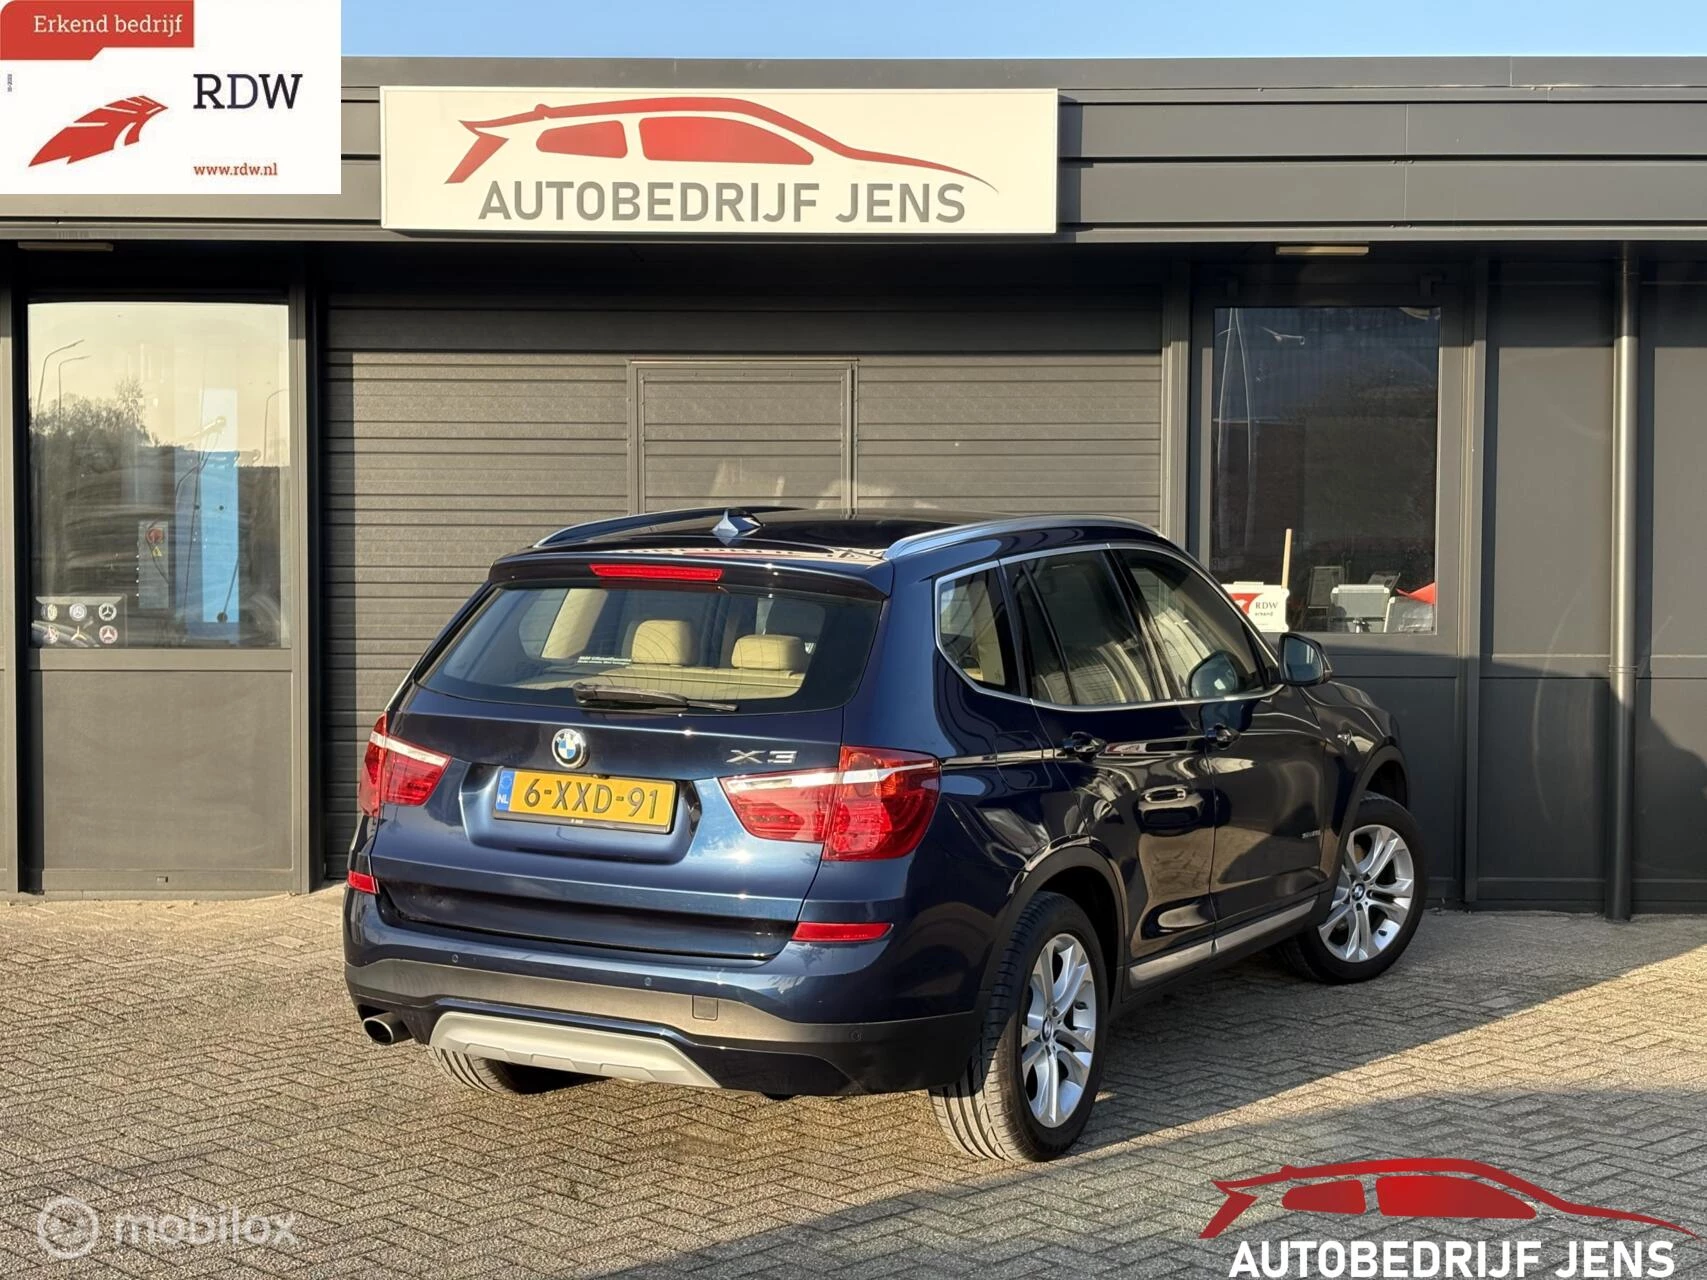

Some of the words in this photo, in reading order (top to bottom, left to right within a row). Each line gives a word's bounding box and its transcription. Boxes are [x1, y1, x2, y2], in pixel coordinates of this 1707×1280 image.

[478, 180, 820, 223] AUTOBEDRIJF
[835, 182, 966, 224] JENS
[1255, 601, 1278, 610] RDW
[726, 749, 798, 764] X3
[497, 794, 509, 805] NL
[523, 778, 659, 819] 6-XXD-91
